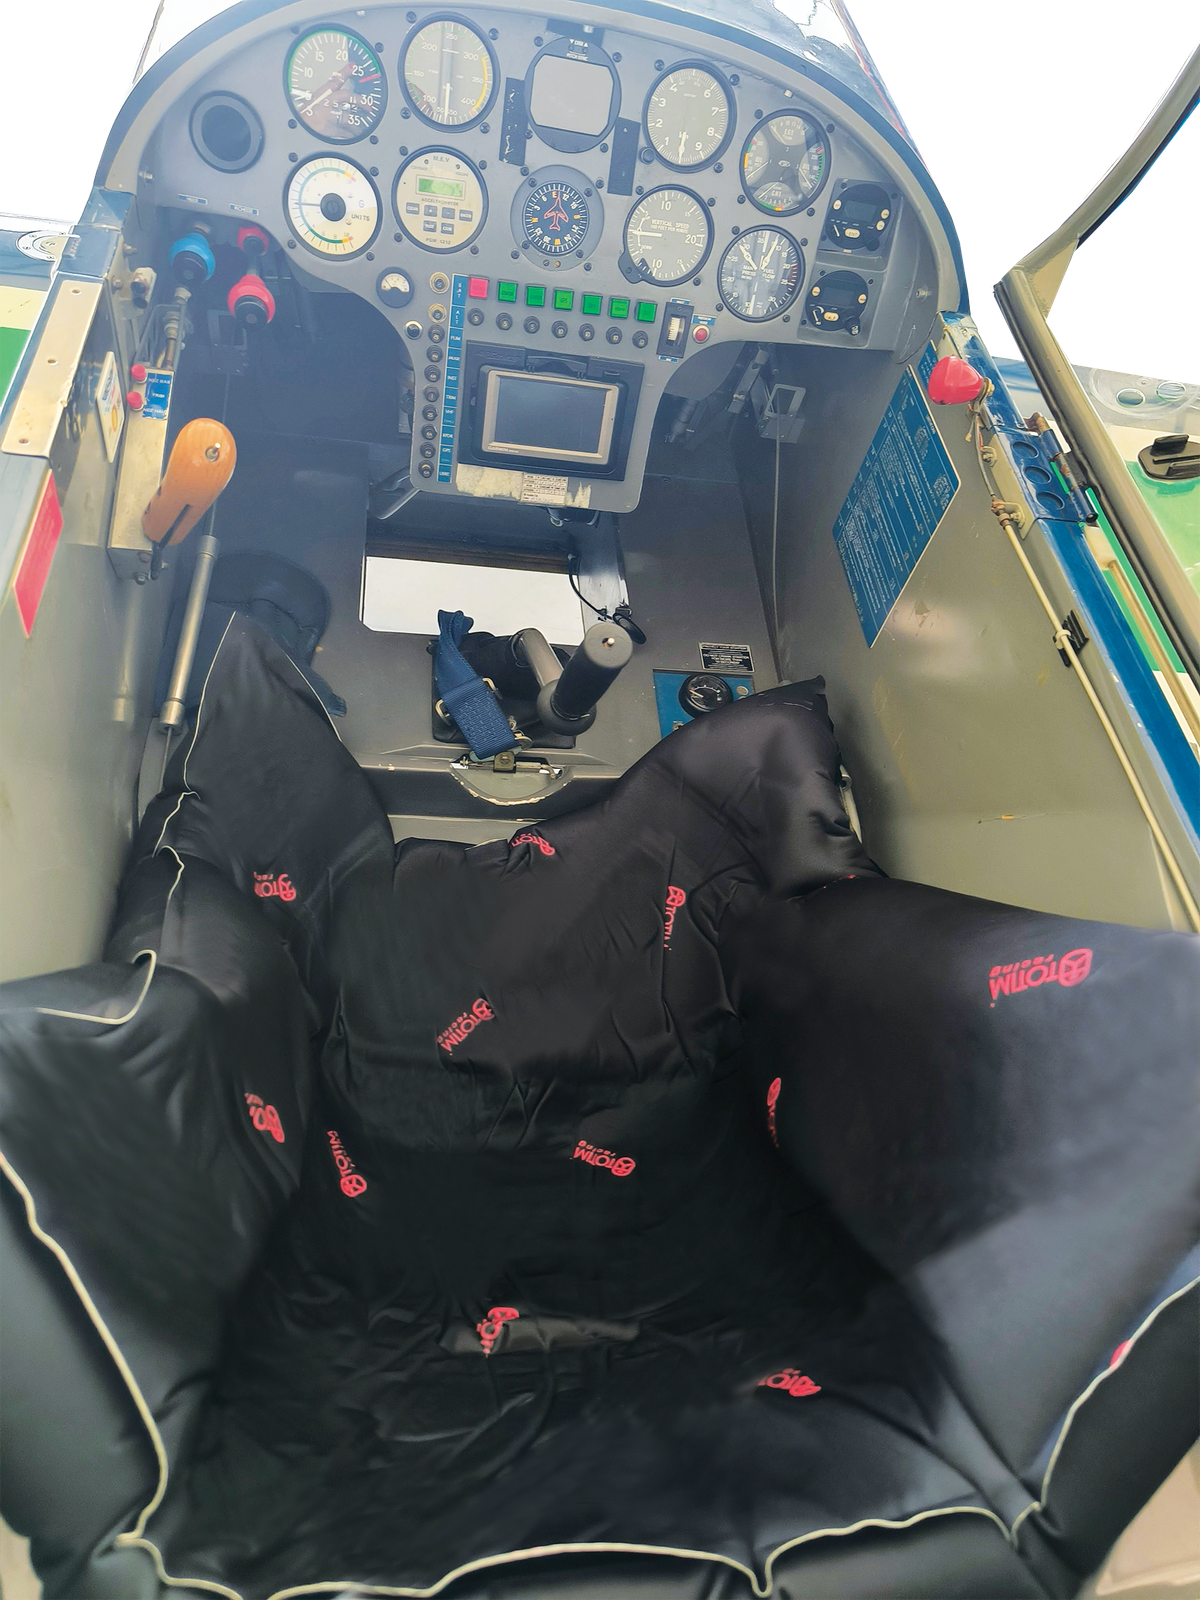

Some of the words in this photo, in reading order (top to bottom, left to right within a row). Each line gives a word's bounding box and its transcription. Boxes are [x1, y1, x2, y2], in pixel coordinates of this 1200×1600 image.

[446, 32, 458, 41] 250
[422, 42, 438, 52] 200
[315, 51, 325, 62] 15
[336, 50, 348, 61] 20
[463, 51, 479, 61] 300
[304, 67, 313, 78] 10
[352, 65, 364, 77] 25
[413, 70, 425, 78] 150
[472, 76, 484, 84] 350
[669, 83, 678, 93] 4
[423, 94, 437, 103] 100
[703, 89, 711, 98] 6
[361, 94, 373, 106] 30
[460, 97, 477, 106] 400
[658, 98, 667, 107] 3
[711, 107, 719, 116] 7
[348, 114, 361, 126] 35
[655, 119, 663, 128] 2
[707, 127, 715, 136] 8
[664, 136, 669, 146] 1
[695, 141, 702, 151] 9
[661, 200, 671, 211] 10
[651, 219, 672, 227] VERTICAL
[685, 234, 697, 244] 20
[652, 259, 662, 268] 10
[989, 954, 1054, 977] racing
[437, 1012, 467, 1043] racing
[578, 1140, 616, 1156] racing
